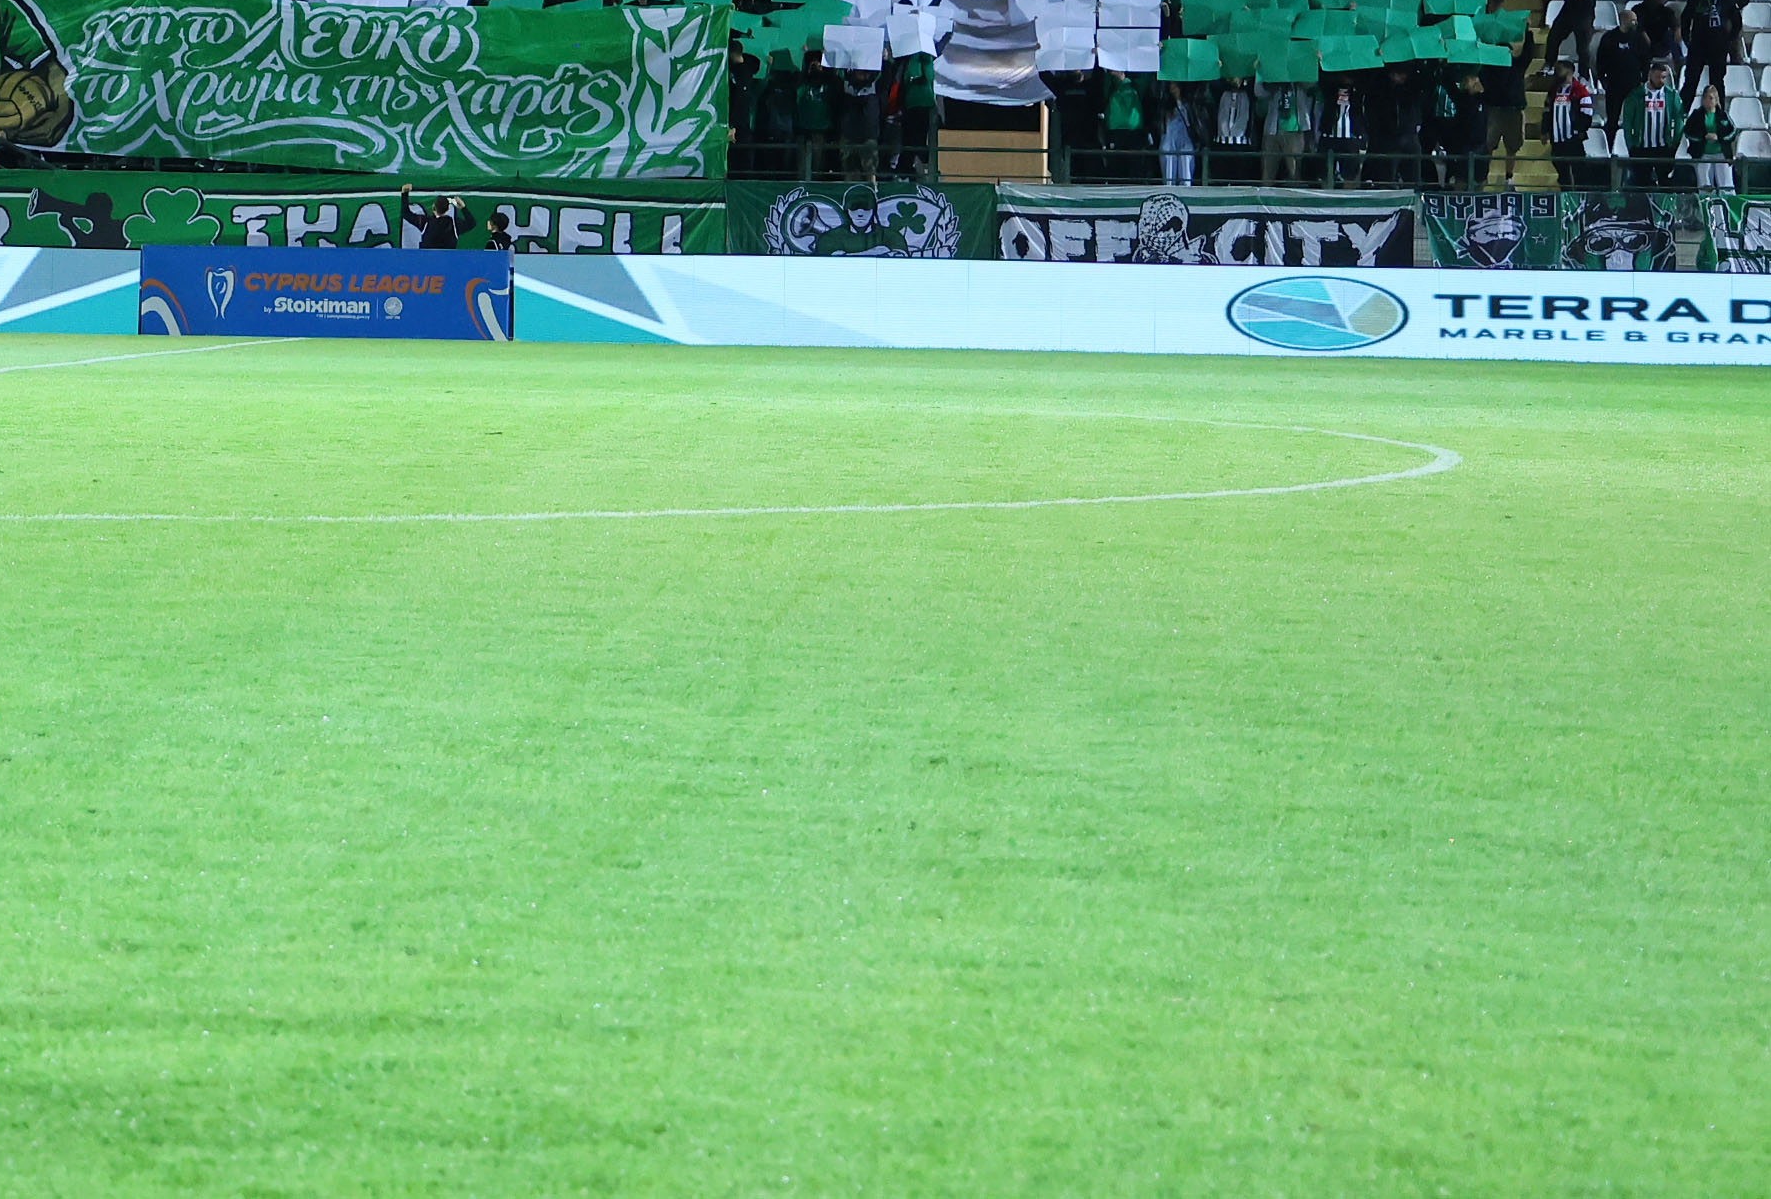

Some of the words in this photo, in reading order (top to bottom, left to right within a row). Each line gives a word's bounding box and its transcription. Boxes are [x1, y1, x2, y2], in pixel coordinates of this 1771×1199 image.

[1211, 211, 1401, 267] CITY
[244, 273, 343, 292] CYPRUS
[347, 274, 445, 294] LEAGUE
[274, 297, 370, 314] Stoiximan
[1434, 294, 1710, 323] TERRA
[1439, 328, 1606, 342] MARBLE
[1624, 331, 1648, 342] &
